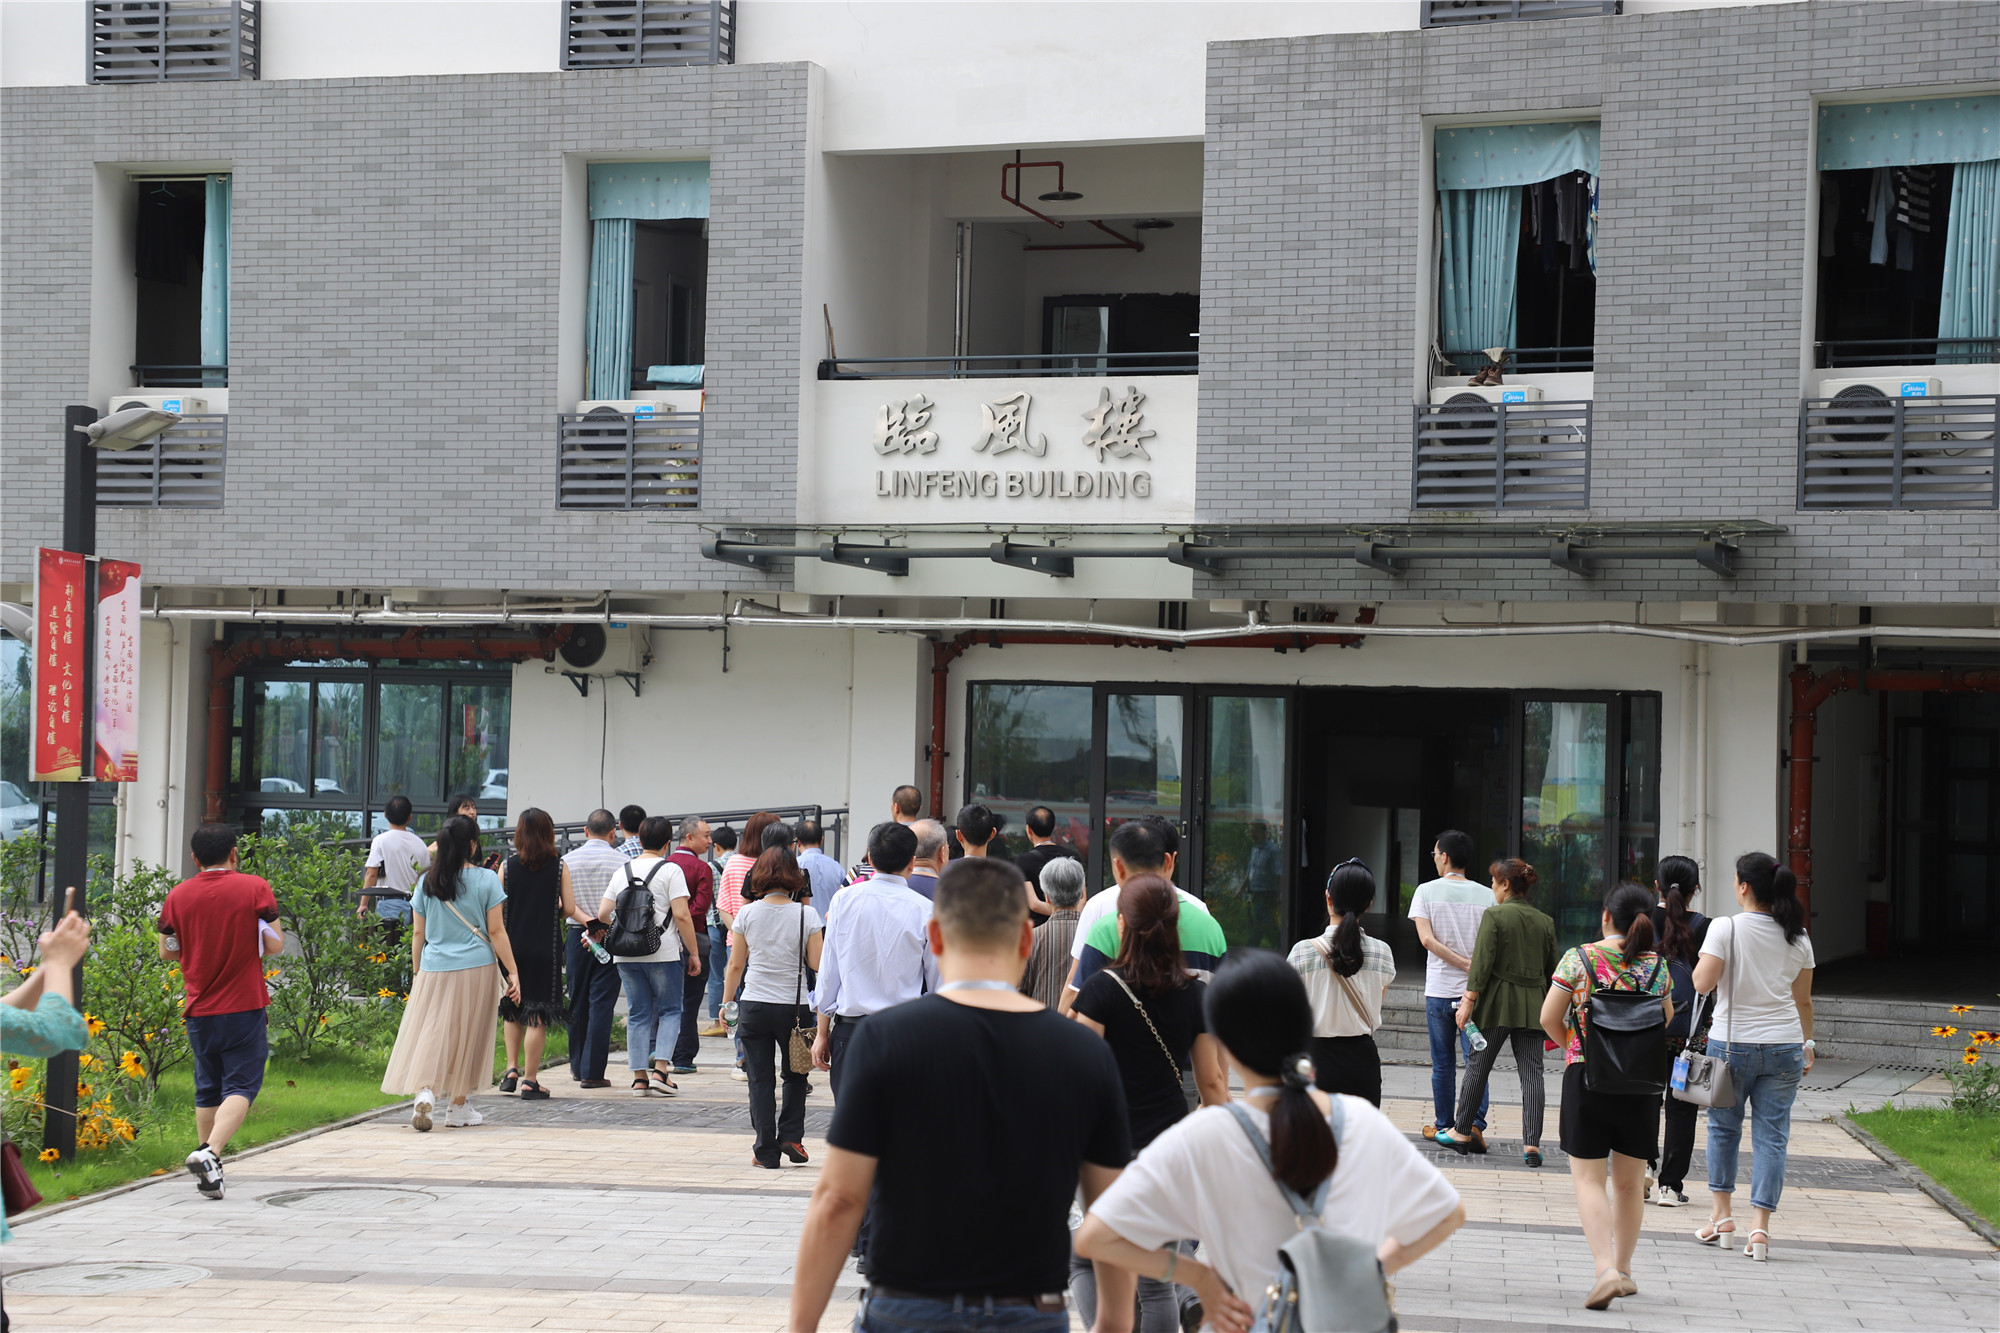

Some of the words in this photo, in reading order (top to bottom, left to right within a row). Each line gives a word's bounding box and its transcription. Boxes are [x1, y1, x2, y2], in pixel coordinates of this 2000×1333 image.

[875, 470, 998, 498] LINFENG
[1005, 470, 1151, 498] BUILDING
[48, 605, 60, 667] 道路自信
[47, 684, 57, 745] 理论自信
[62, 661, 72, 723] 文化自信
